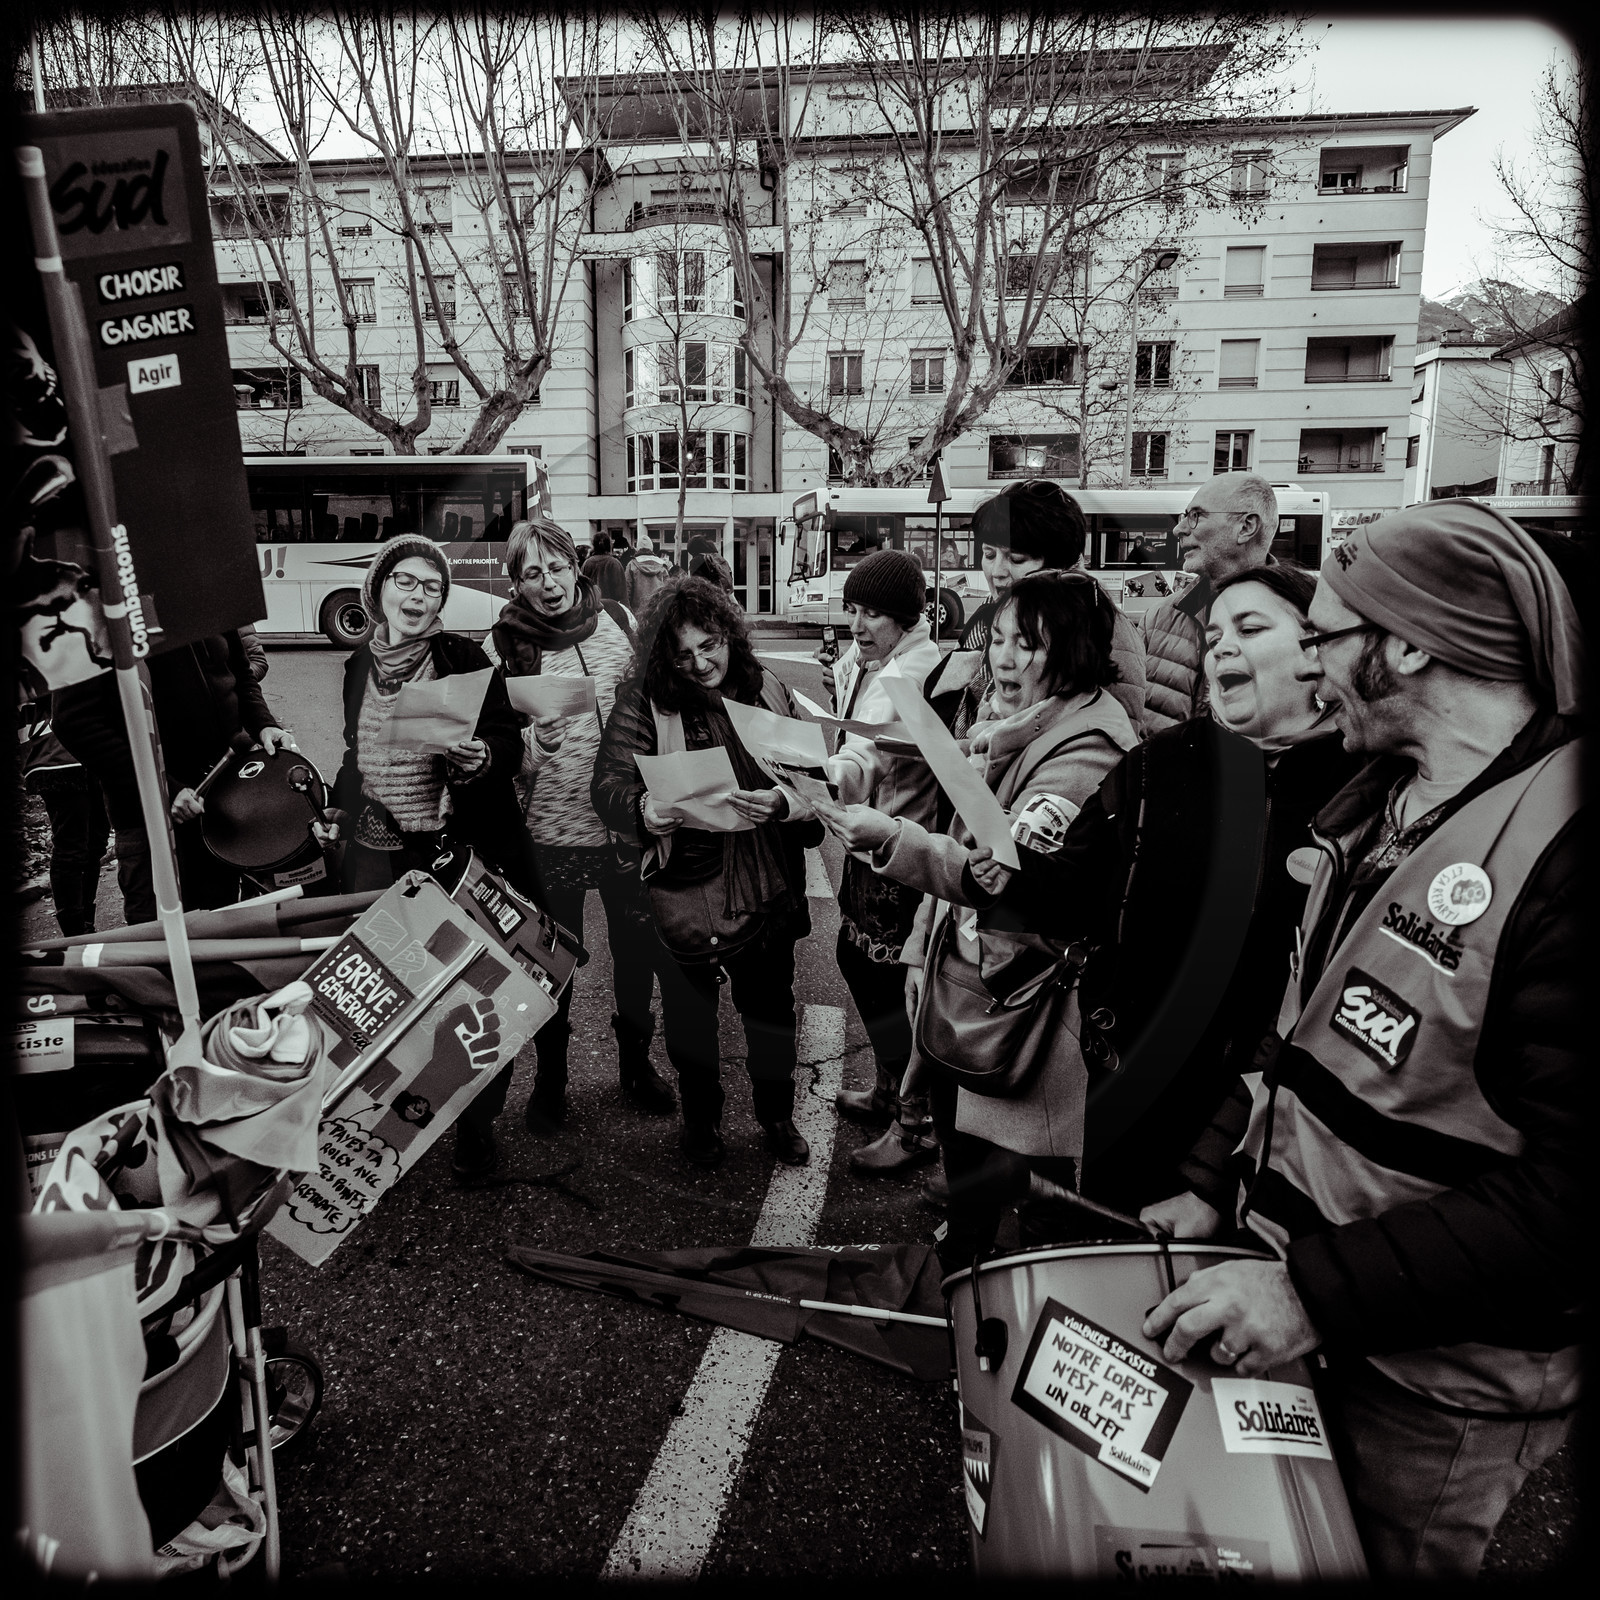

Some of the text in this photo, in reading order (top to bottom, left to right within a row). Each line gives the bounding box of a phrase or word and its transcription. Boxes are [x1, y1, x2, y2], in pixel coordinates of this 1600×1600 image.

[99, 265, 183, 300] CHOISIR
[101, 308, 195, 345] GAGNER
[139, 363, 172, 385] Agir
[111, 523, 150, 658] Combattons
[1382, 902, 1463, 971] Solidaires
[318, 976, 377, 1032] GÉNÉRALE
[335, 953, 398, 1014] GRÈVE
[320, 1143, 382, 1188] ROLEX AVEC
[328, 1122, 383, 1168] PAYES TA
[319, 1163, 336, 1182] TES
[1052, 1333, 1158, 1407] NOTRE CORPS
[1109, 1342, 1158, 1377] SEXISTES
[1046, 1383, 1125, 1441] UN OBJET
[1053, 1360, 1136, 1421] N'EST PAS
[1234, 1400, 1321, 1438] Solidaires
